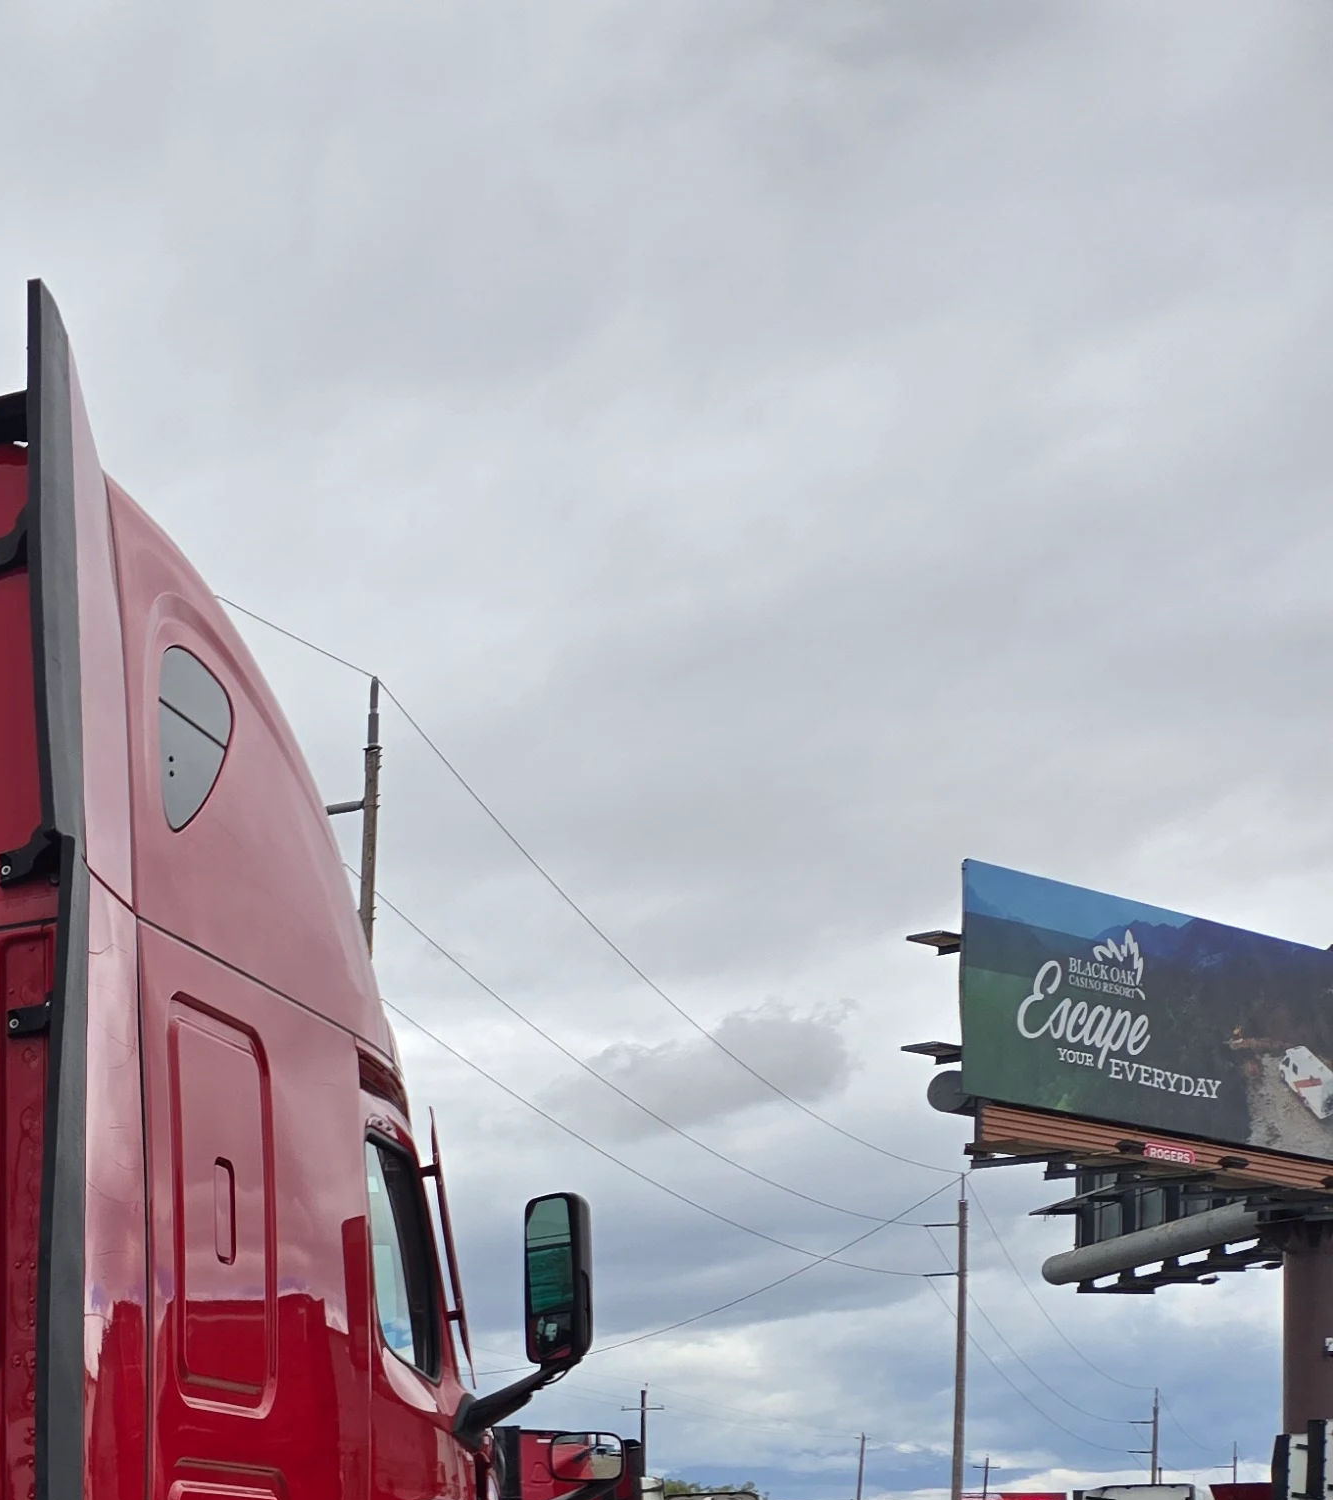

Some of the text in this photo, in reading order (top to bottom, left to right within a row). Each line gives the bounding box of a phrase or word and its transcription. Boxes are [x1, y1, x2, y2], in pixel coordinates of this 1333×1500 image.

[1068, 956, 1136, 987] BLACK OAK
[1068, 974, 1136, 999] CASINO RESORT
[1017, 960, 1151, 1070] Escape
[1057, 1047, 1222, 1099] YOUR EVERYDAY
[1149, 1147, 1191, 1164] ROGERS
